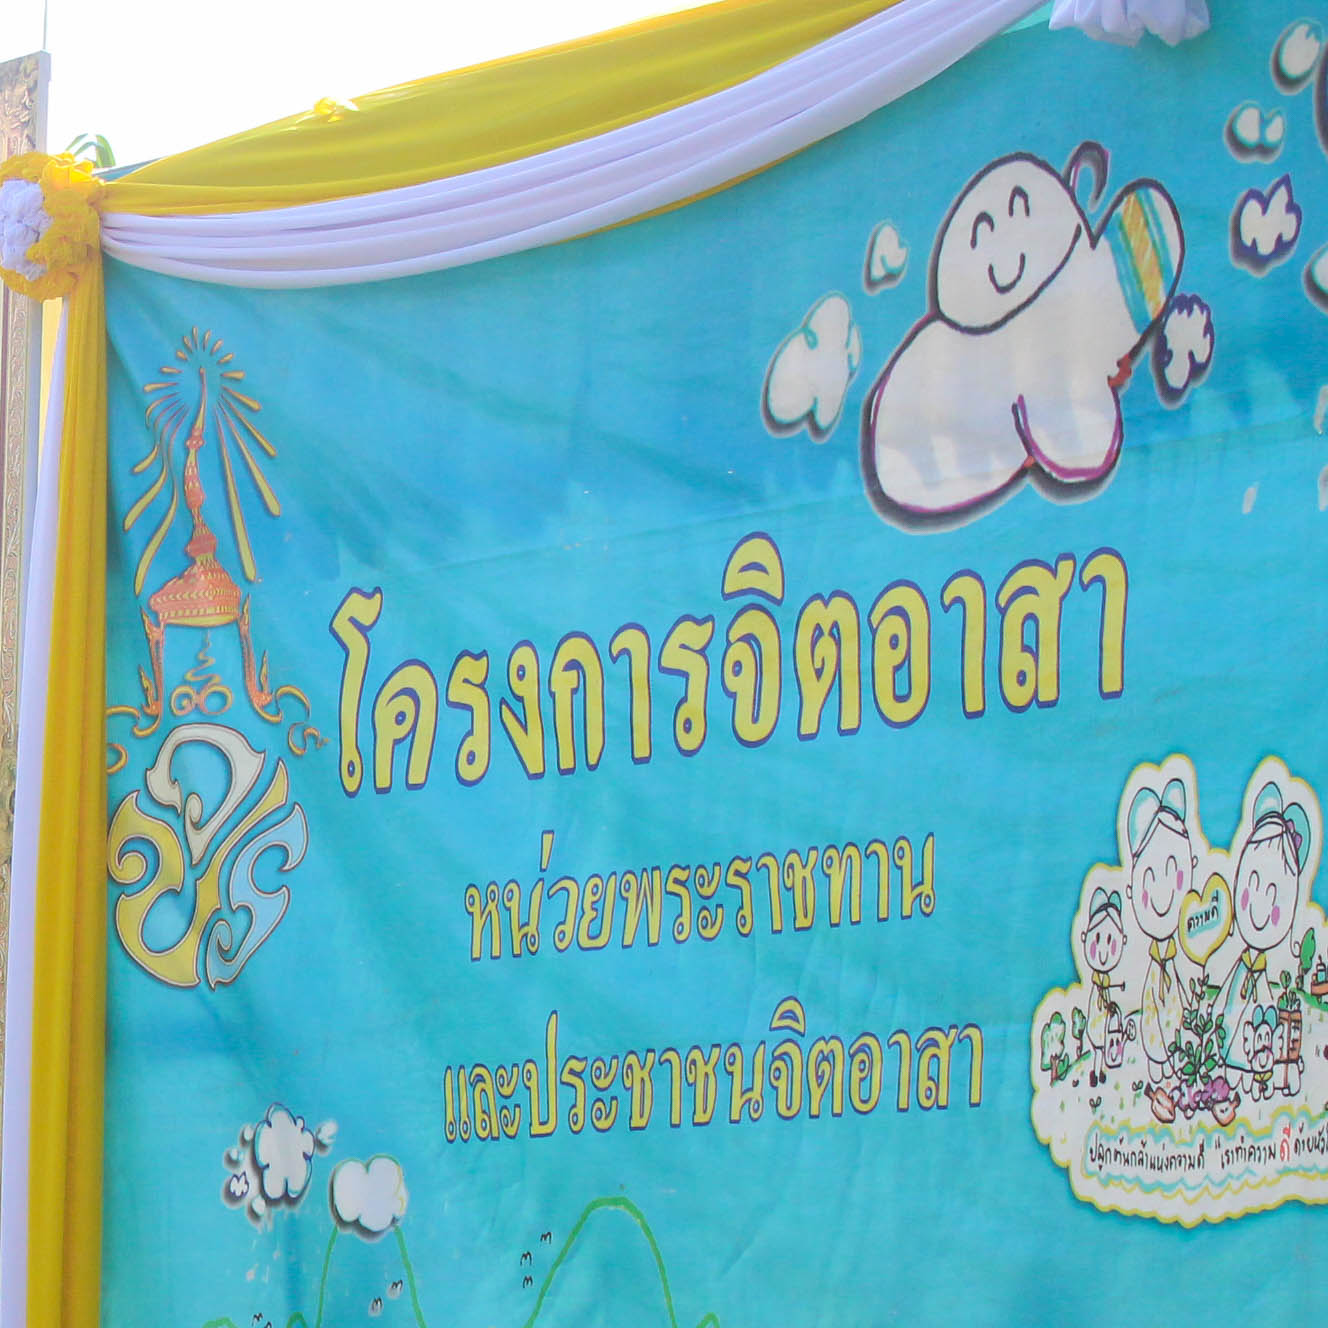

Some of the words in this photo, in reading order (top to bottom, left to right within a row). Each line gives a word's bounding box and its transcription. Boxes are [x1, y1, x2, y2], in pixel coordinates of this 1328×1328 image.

[329, 531, 1129, 798] โครงการจิตอาสา
[464, 830, 937, 963] หน่วยพระราชทาน
[443, 995, 986, 1144] และประชาชนจิตอาสา
